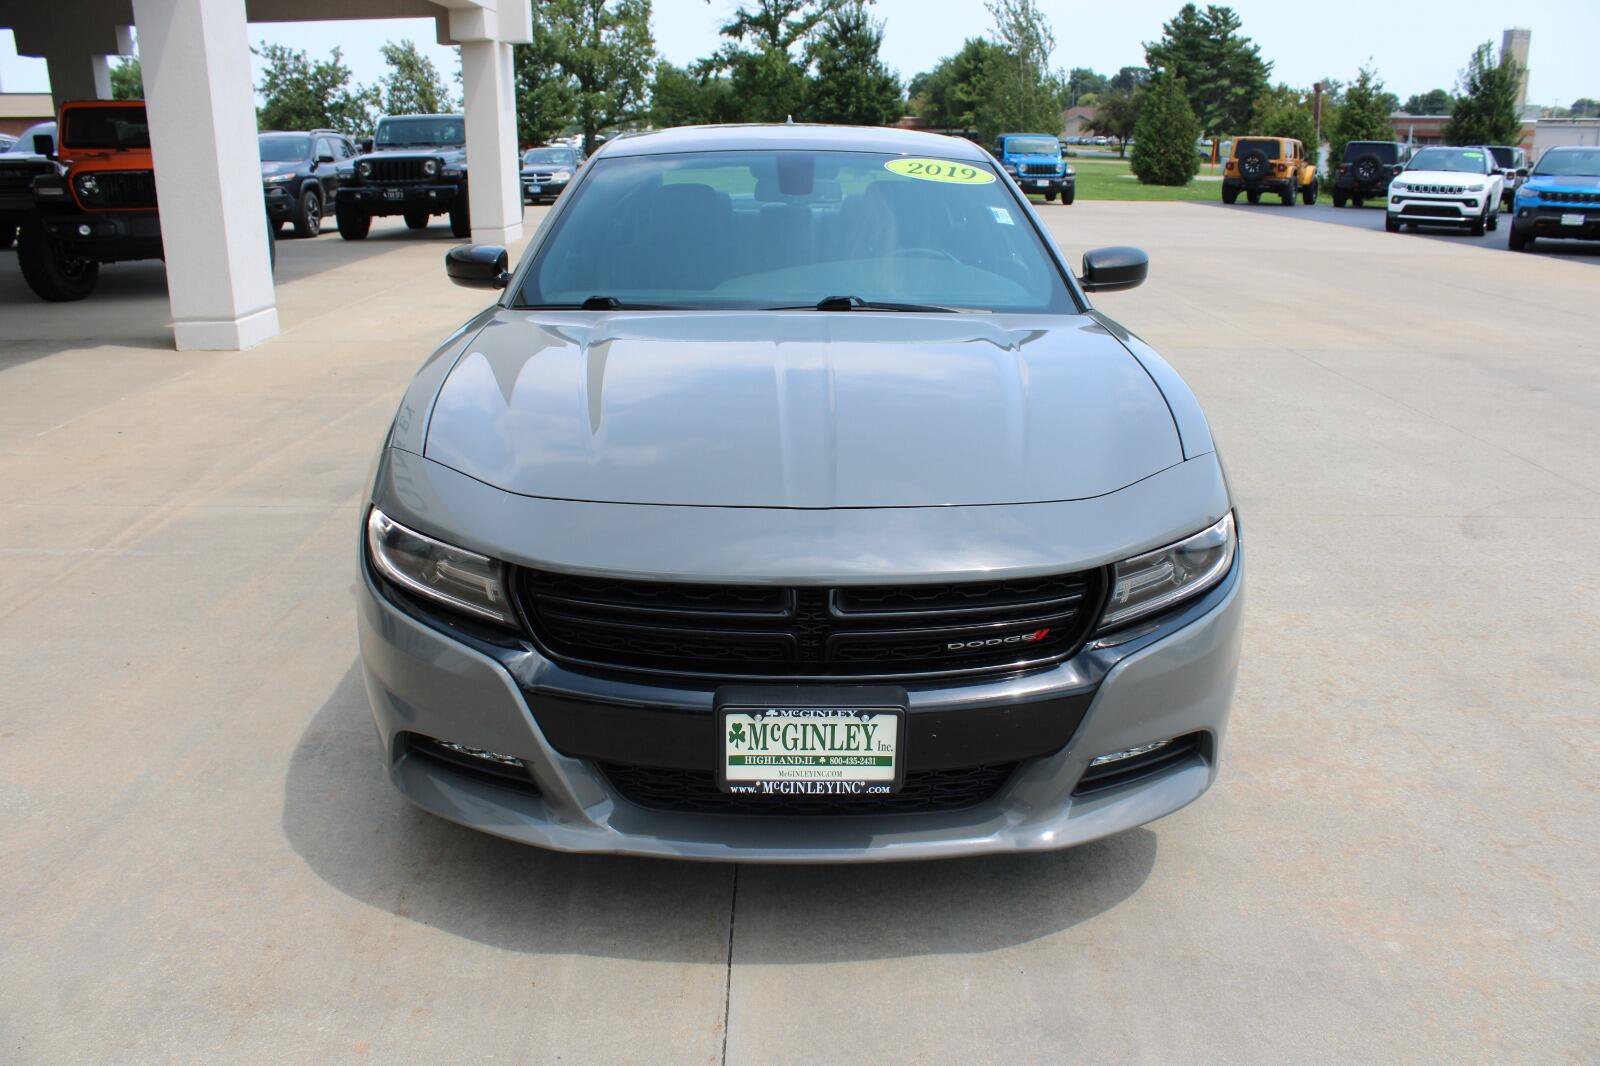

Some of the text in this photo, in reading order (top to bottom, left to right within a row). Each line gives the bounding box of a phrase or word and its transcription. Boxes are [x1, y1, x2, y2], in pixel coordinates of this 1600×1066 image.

[907, 162, 977, 180] 2019
[947, 632, 1037, 650] DODGE
[780, 710, 858, 718] McGINLEY
[747, 722, 893, 752] McGINLEY Inc.
[829, 756, 876, 765] 800-435-2431
